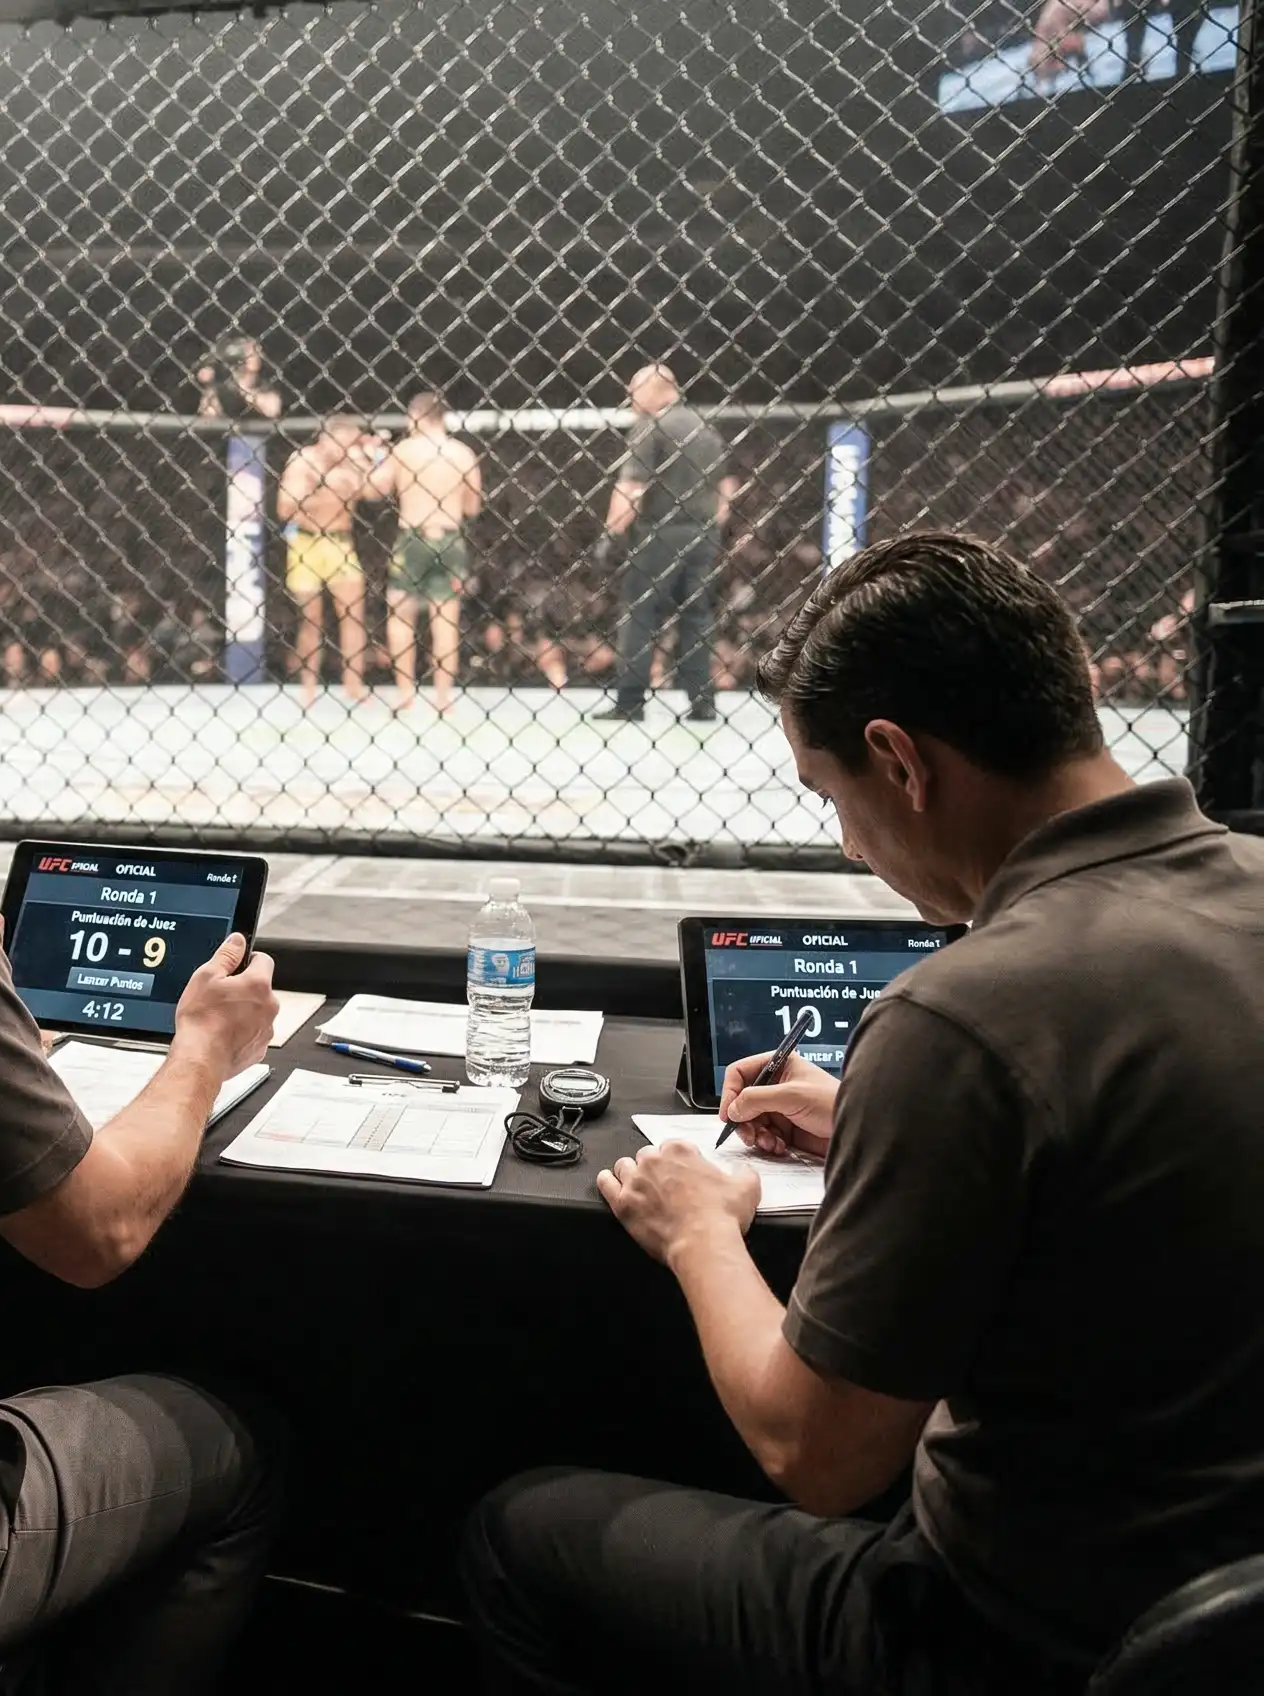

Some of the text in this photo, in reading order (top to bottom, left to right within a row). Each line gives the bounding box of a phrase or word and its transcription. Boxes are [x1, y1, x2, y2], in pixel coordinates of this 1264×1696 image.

[38, 856, 73, 871] UFC
[100, 886, 157, 904] Ronda 1
[148, 917, 177, 931] Juez
[711, 932, 749, 946] UFC
[69, 929, 167, 968] 10 - 9
[794, 958, 858, 975] Ronda 1
[770, 985, 837, 999] Puntuación
[841, 985, 858, 999] de
[81, 1000, 125, 1021] 4:12
[774, 1005, 822, 1038] 10
